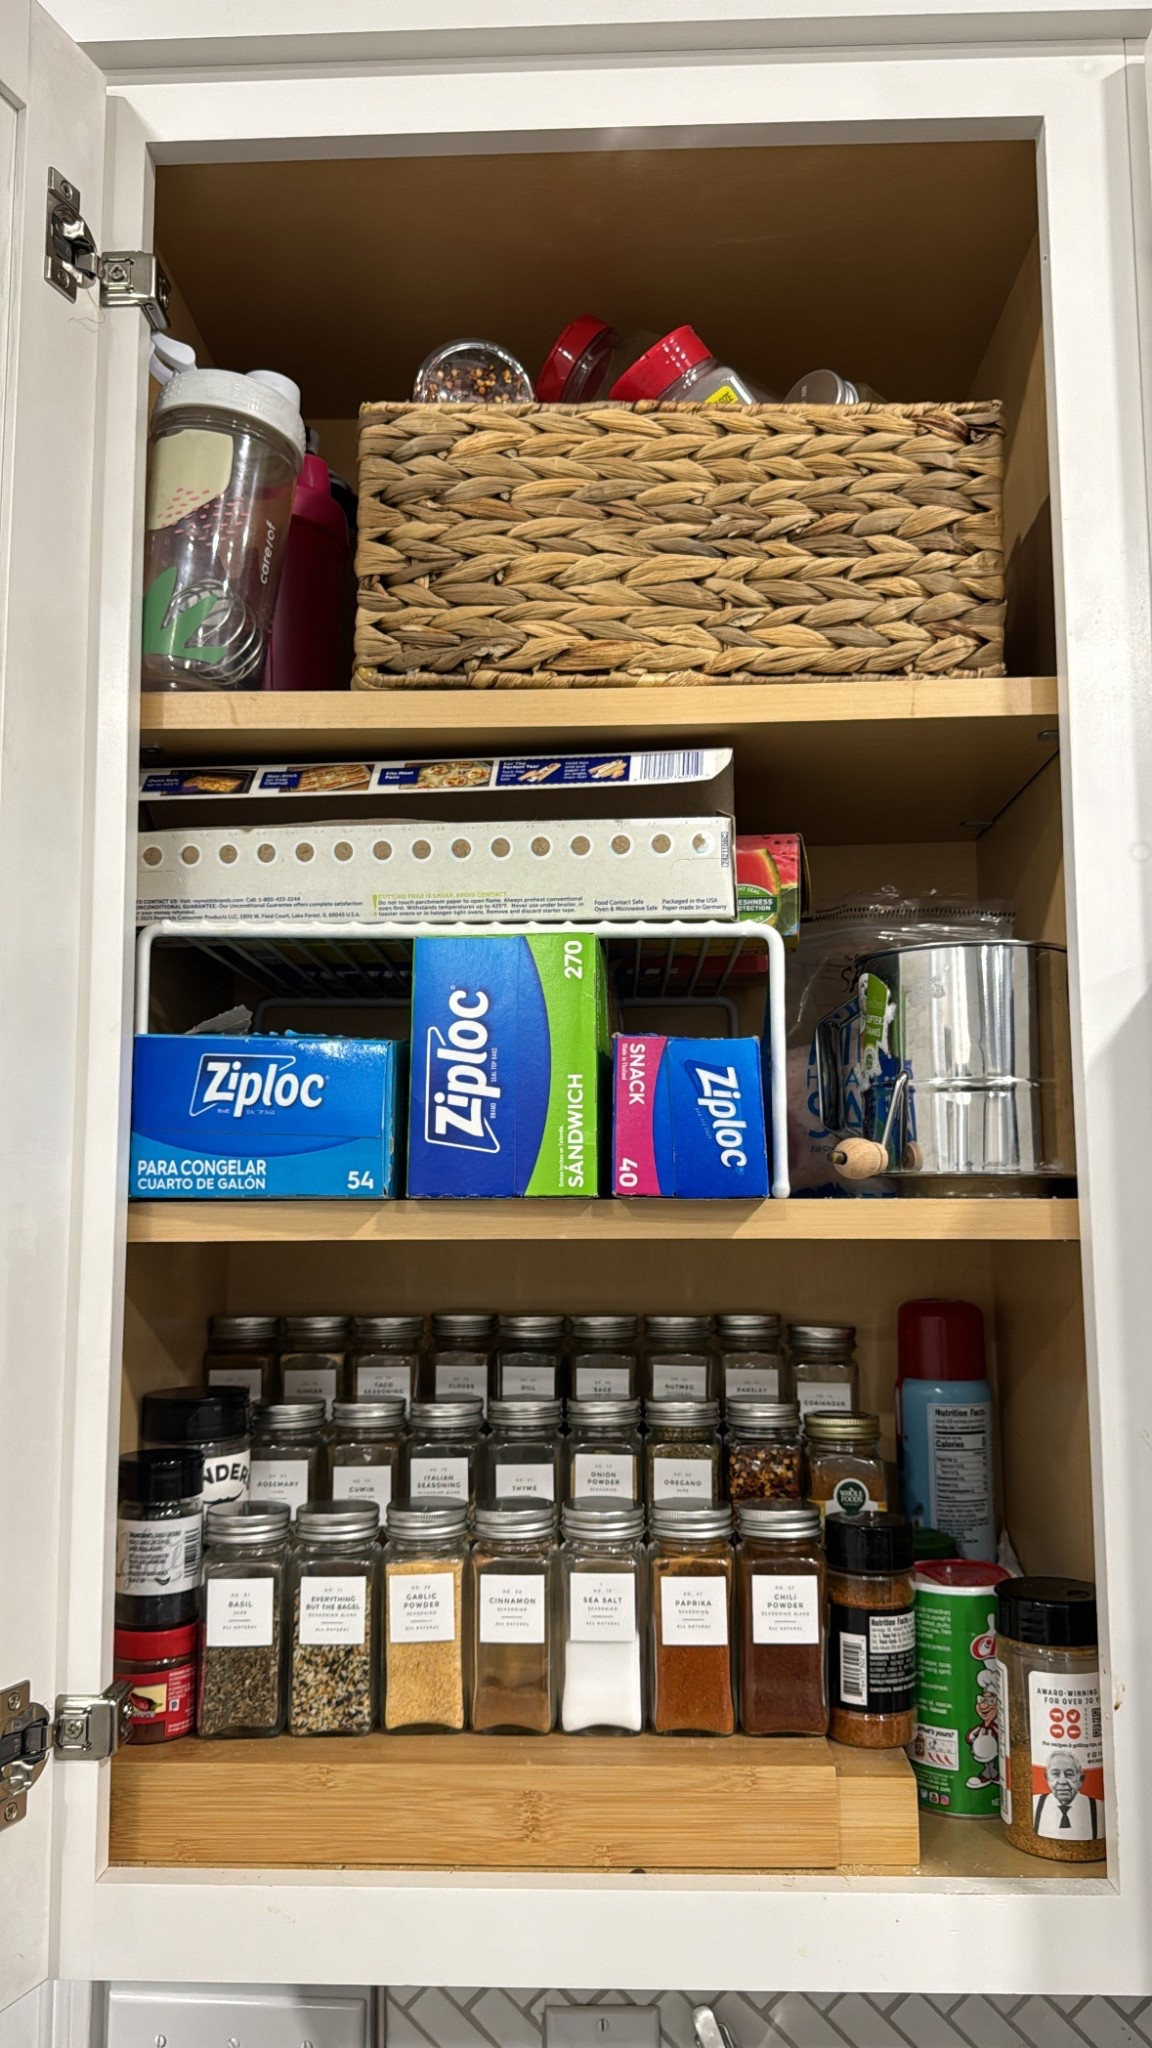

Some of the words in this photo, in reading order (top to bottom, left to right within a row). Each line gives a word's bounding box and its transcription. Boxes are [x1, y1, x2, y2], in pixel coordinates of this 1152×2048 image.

[260, 520, 278, 585] care/of
[564, 940, 583, 980] 270
[433, 989, 501, 1137] Ziploc
[628, 1043, 646, 1105] SNACK
[202, 1060, 324, 1118] Ziploc
[562, 1073, 584, 1188] SÁNDWICH
[694, 1066, 748, 1168] Ziploc
[137, 1159, 178, 1176] PARA
[181, 1160, 267, 1176] CONGELAR
[137, 1178, 193, 1190] CUARTO
[196, 1178, 214, 1190] DE
[217, 1175, 266, 1190] GALÓN
[347, 1170, 374, 1189] 54
[619, 1157, 638, 1187] 40
[1037, 1688, 1098, 1697] AWARD-WINNING
